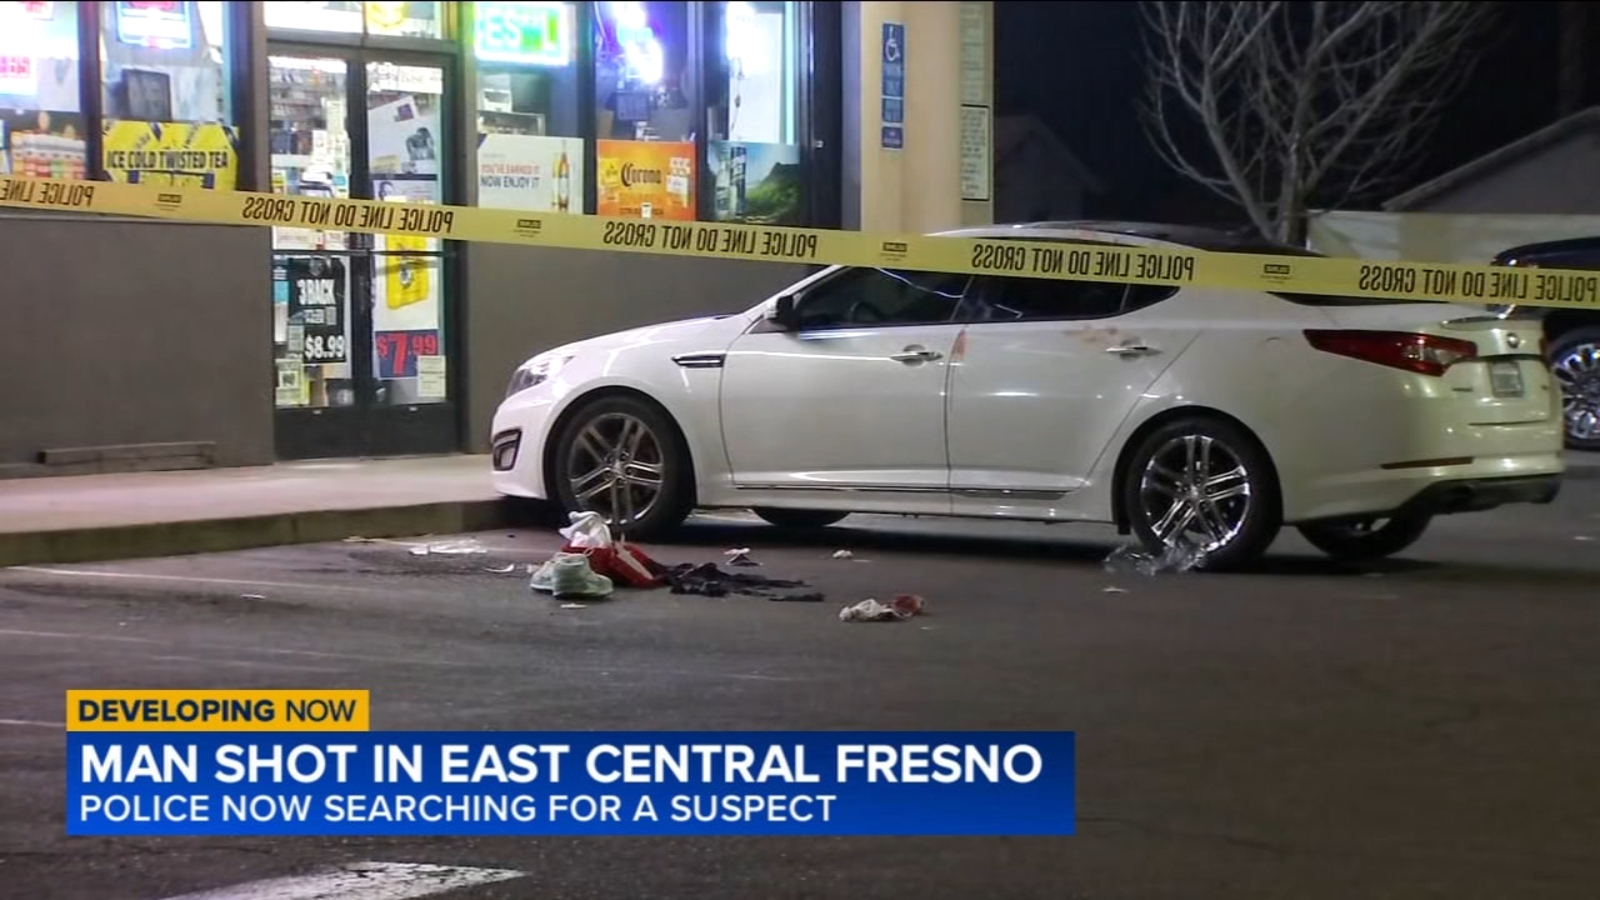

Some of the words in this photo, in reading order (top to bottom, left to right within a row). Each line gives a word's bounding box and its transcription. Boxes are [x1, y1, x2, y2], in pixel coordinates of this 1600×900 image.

[106, 150, 125, 169] ICE
[127, 150, 157, 169] COLD
[159, 150, 206, 170] TWISTED
[209, 151, 228, 169] TEA
[480, 175, 501, 188] NOW
[503, 176, 531, 189] ENJOY
[621, 162, 661, 187] Corona
[304, 334, 345, 360] $8.99
[376, 332, 438, 376] $7.99
